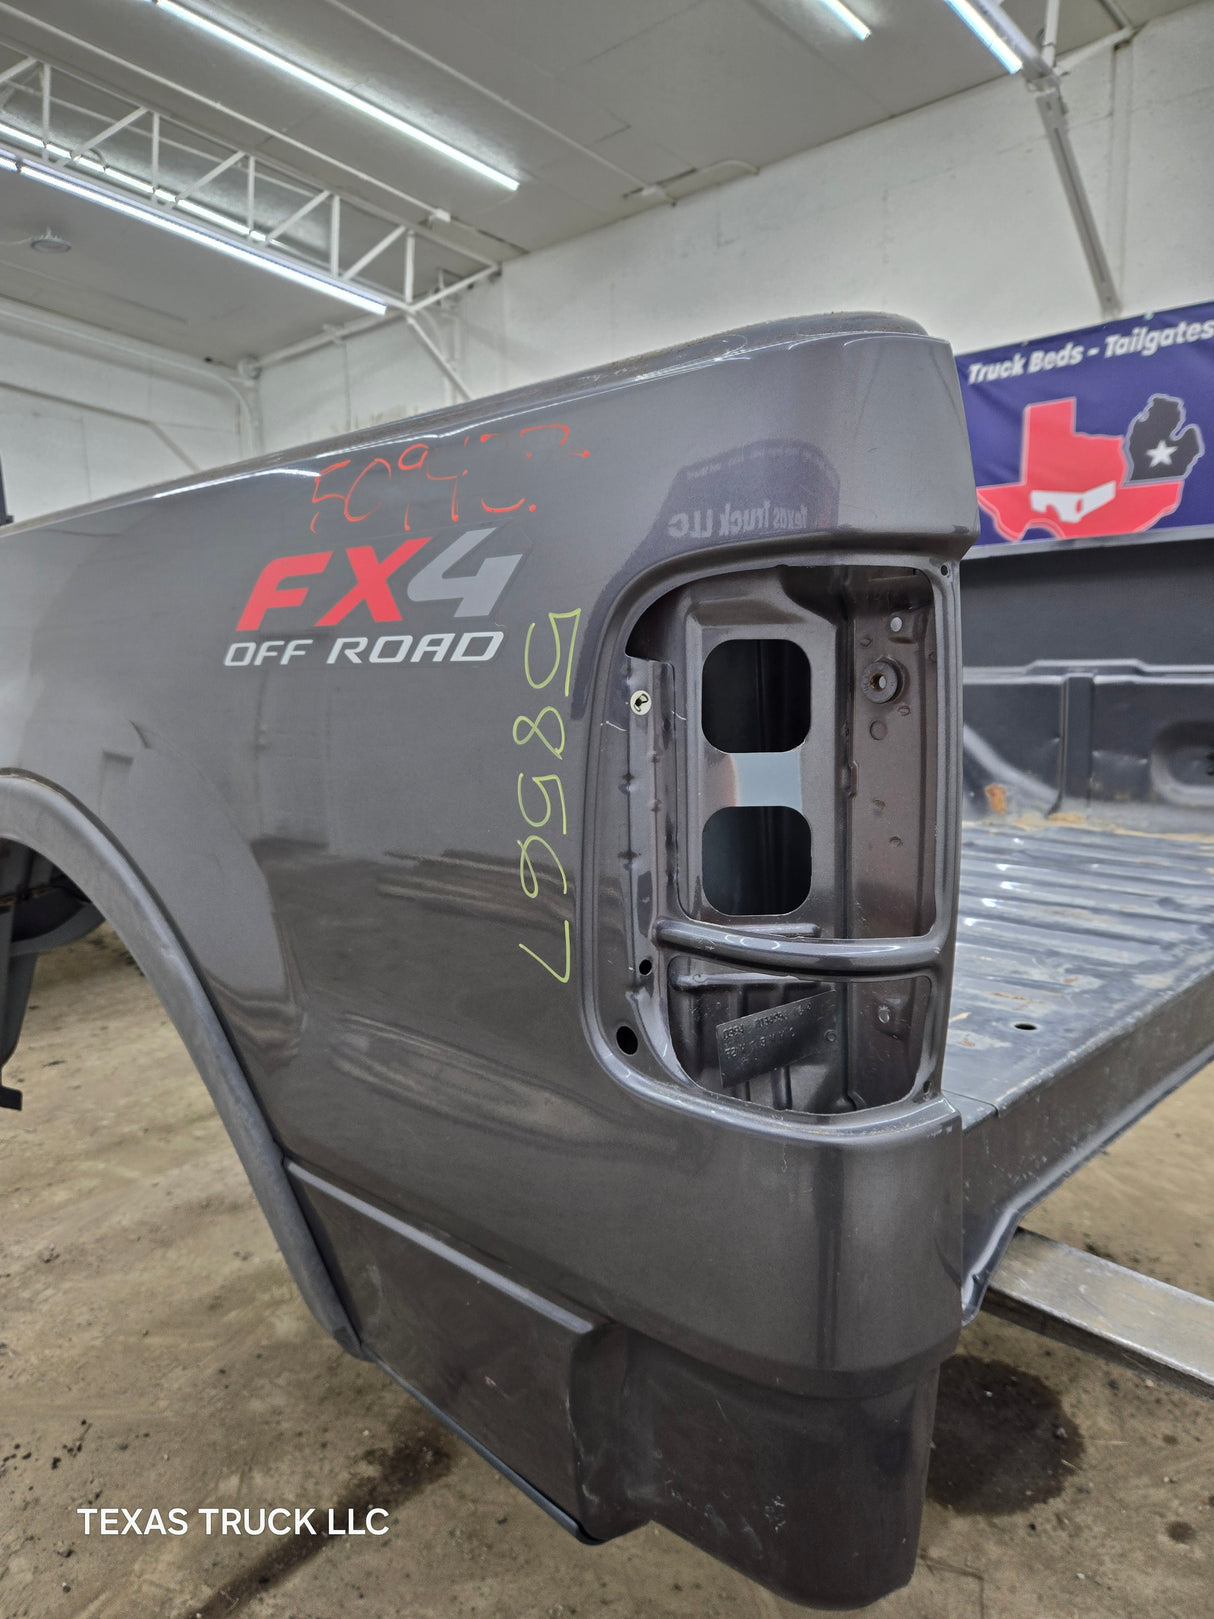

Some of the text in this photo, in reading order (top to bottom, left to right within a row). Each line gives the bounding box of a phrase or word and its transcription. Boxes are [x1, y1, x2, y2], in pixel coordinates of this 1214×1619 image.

[968, 353, 1029, 385] Truck
[1028, 342, 1084, 374] Beds
[1104, 319, 1214, 359] Tailgates
[235, 527, 523, 631] FX4
[223, 631, 504, 666] OFF ROAD
